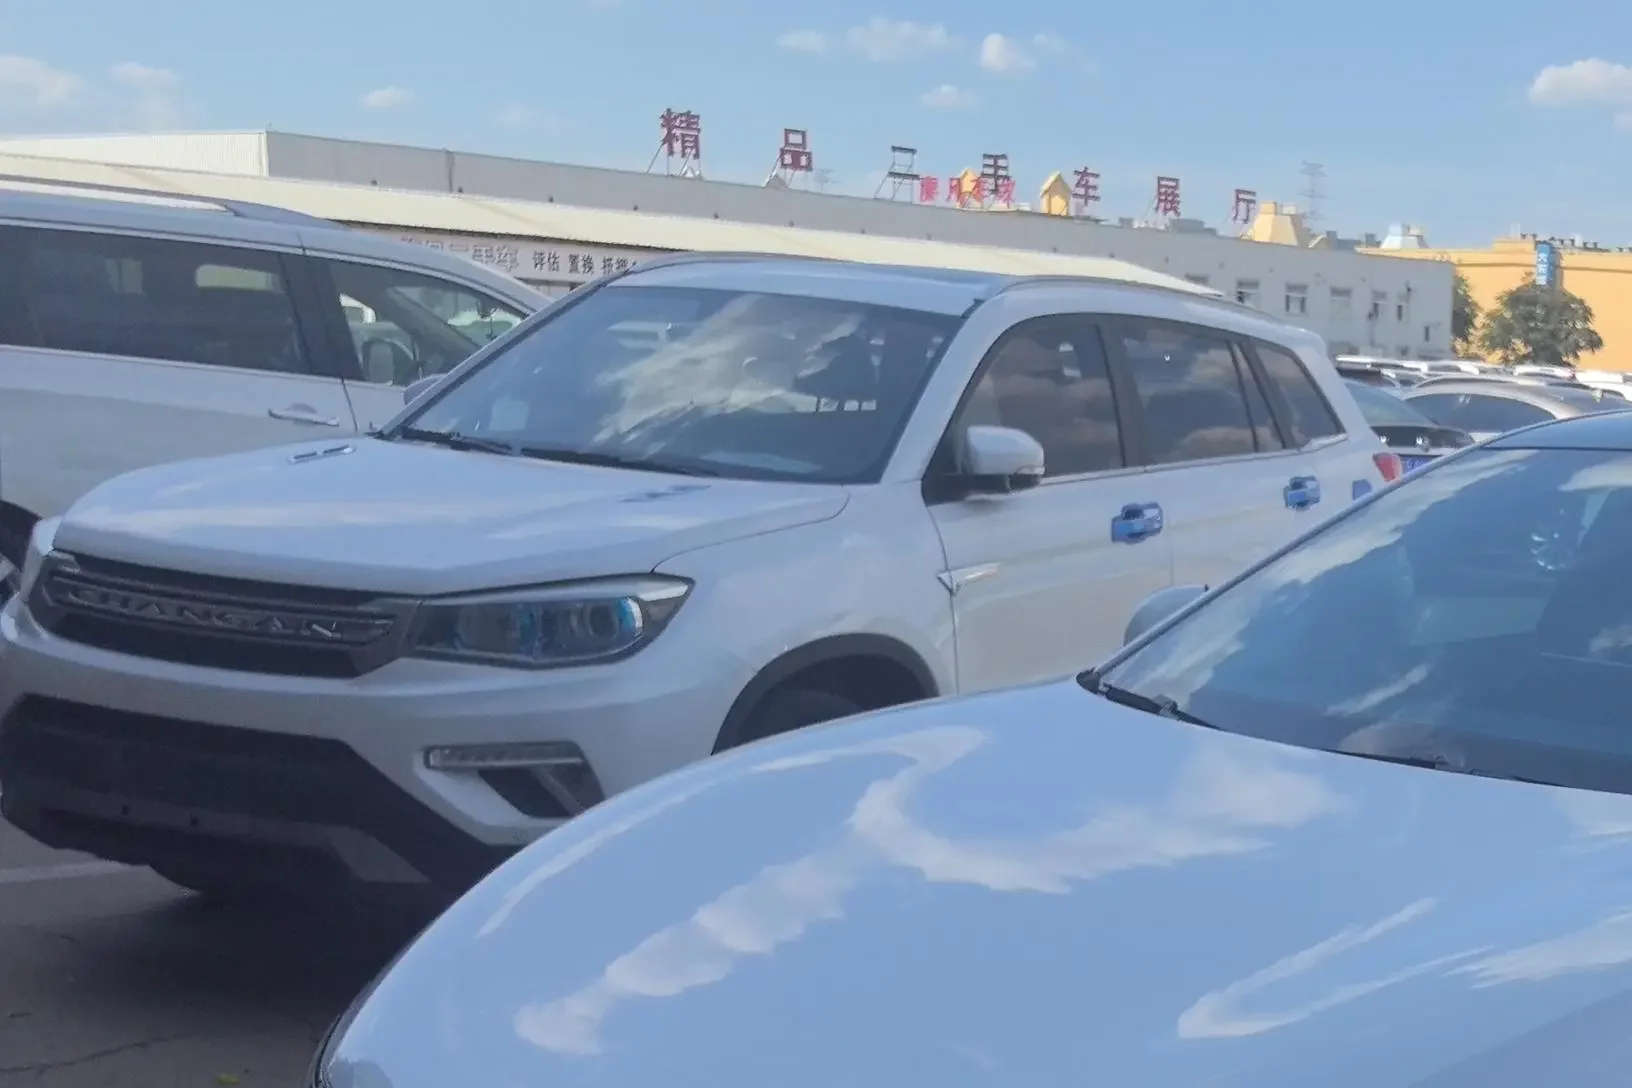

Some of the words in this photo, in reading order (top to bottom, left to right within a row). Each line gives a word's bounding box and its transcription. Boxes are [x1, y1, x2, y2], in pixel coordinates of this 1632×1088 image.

[659, 107, 1257, 224] 精品二手车展厅
[67, 588, 342, 640] CHANGAN
